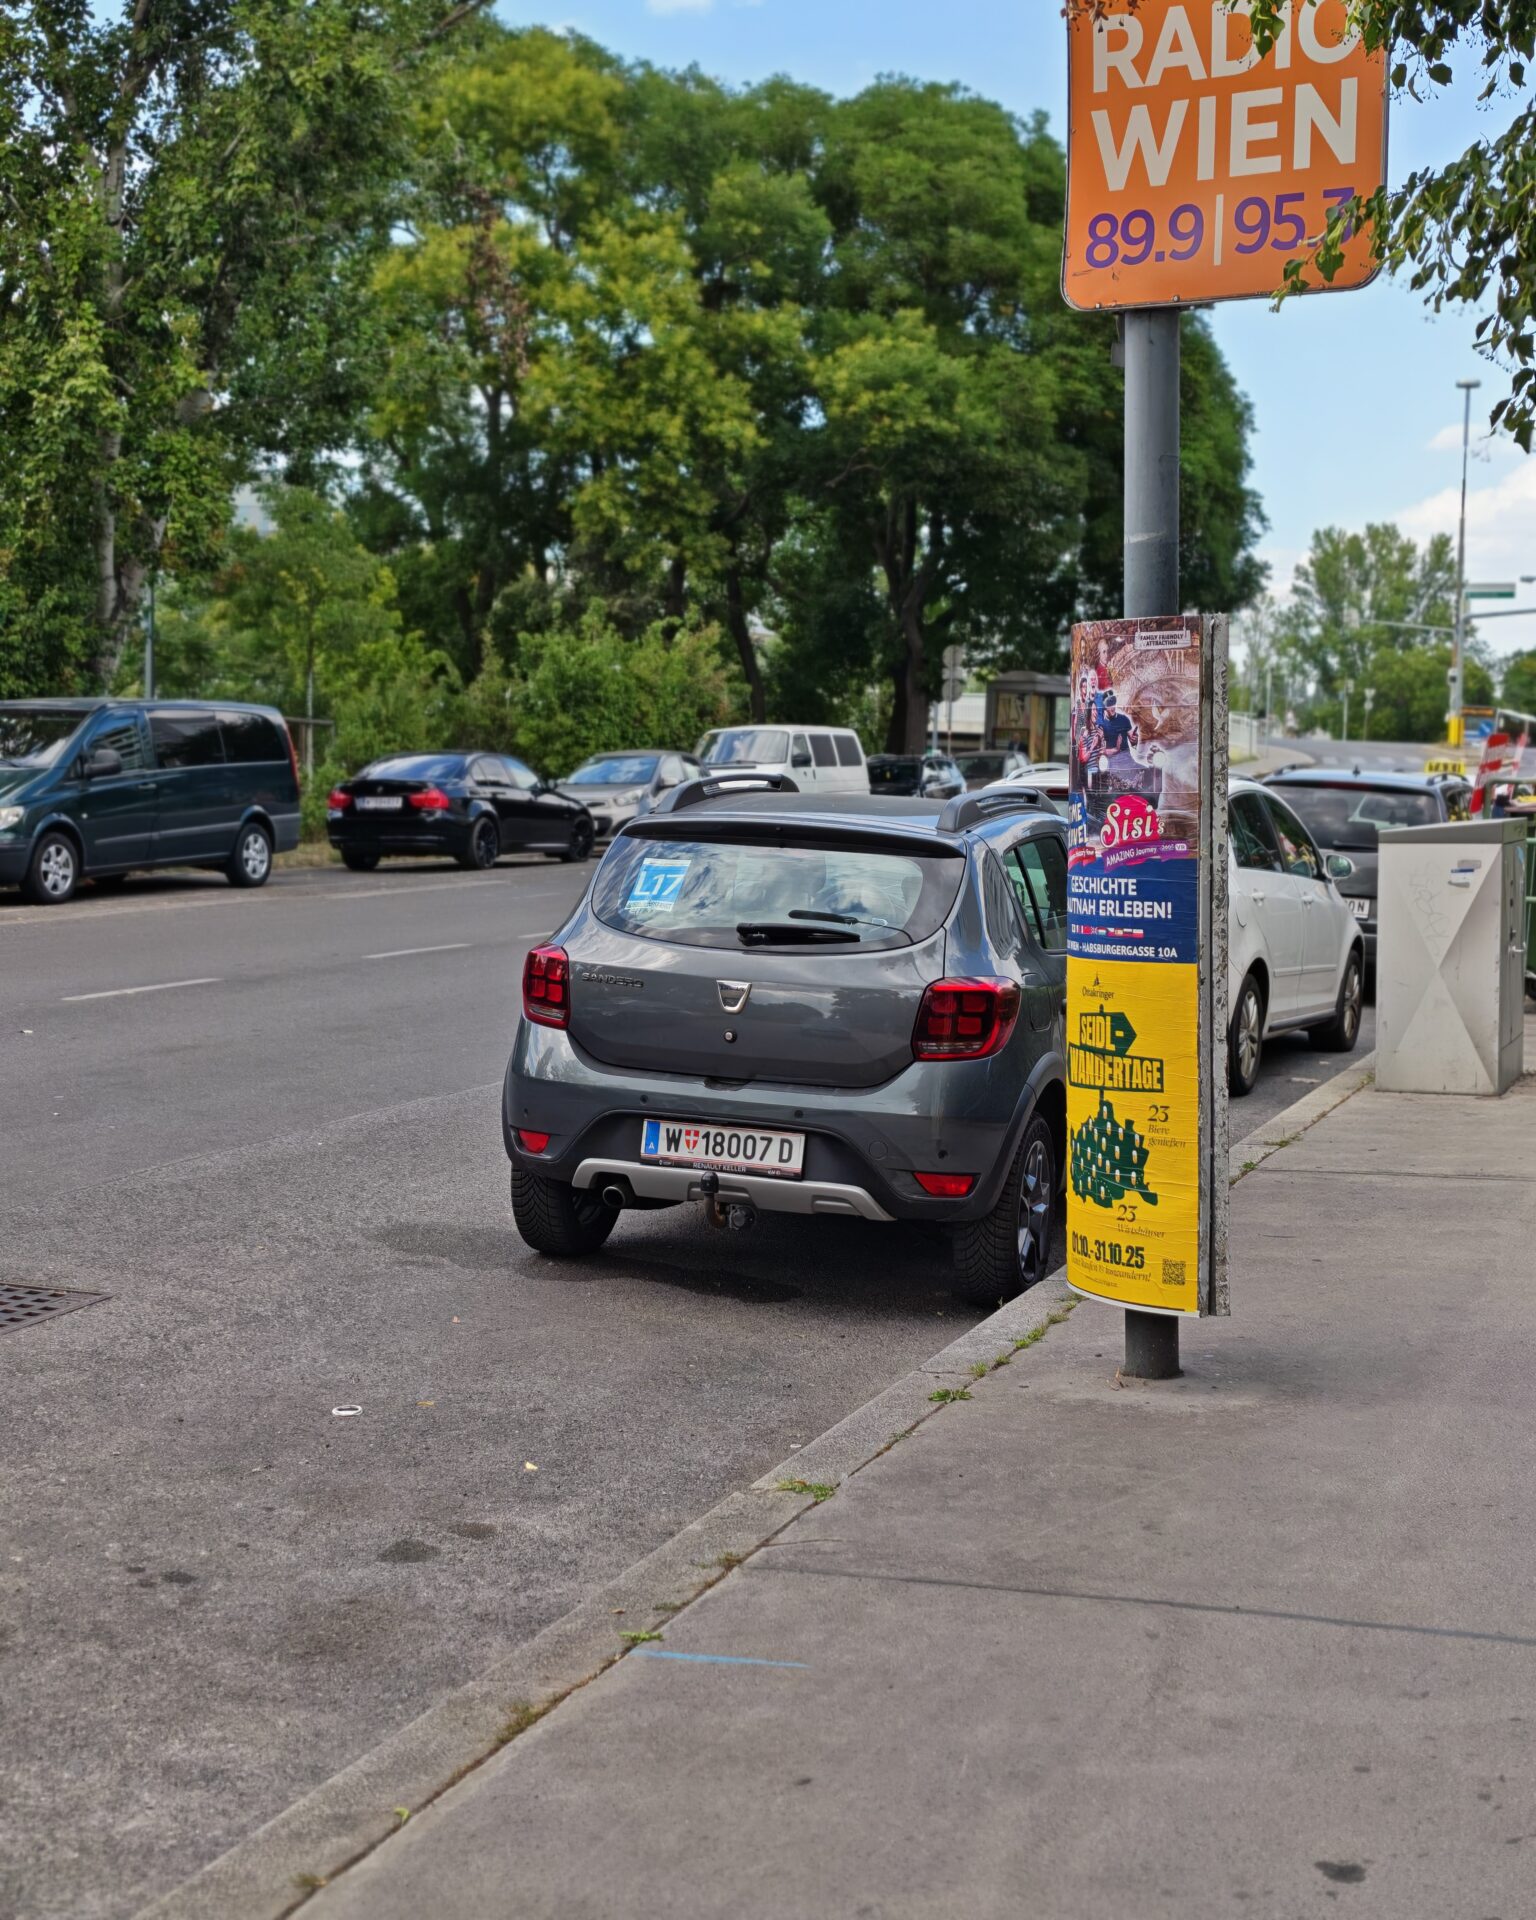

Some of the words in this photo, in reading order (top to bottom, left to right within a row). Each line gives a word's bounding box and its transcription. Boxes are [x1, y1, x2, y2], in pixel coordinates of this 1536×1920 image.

[1092, 0, 1360, 93] RADIO
[1090, 77, 1358, 192] WIEN
[1085, 203, 1204, 269] 89.9
[1145, 639, 1178, 647] ATTRACTION
[1100, 803, 1165, 848] Sisi's
[1106, 848, 1135, 867] AMAZING
[1135, 846, 1157, 857] Journey
[634, 871, 686, 896] L17
[1071, 875, 1137, 896] GESCHICHTE
[1099, 899, 1172, 919] ERLEBEN!
[1082, 942, 1155, 957] HABSBURGERGASSE
[1158, 947, 1178, 958] 10A
[582, 972, 644, 989] SANDERO
[1081, 1015, 1124, 1051] SEIDL-
[1070, 1046, 1162, 1090] WANDERTAGE
[1147, 1104, 1170, 1123] 23
[1148, 1124, 1170, 1135] Biere
[666, 1127, 682, 1153] W
[701, 1131, 773, 1162] 18007
[778, 1137, 793, 1164] D
[692, 1162, 722, 1171] RENAULT
[722, 1165, 746, 1173] KELLER
[1116, 1204, 1138, 1223] 23
